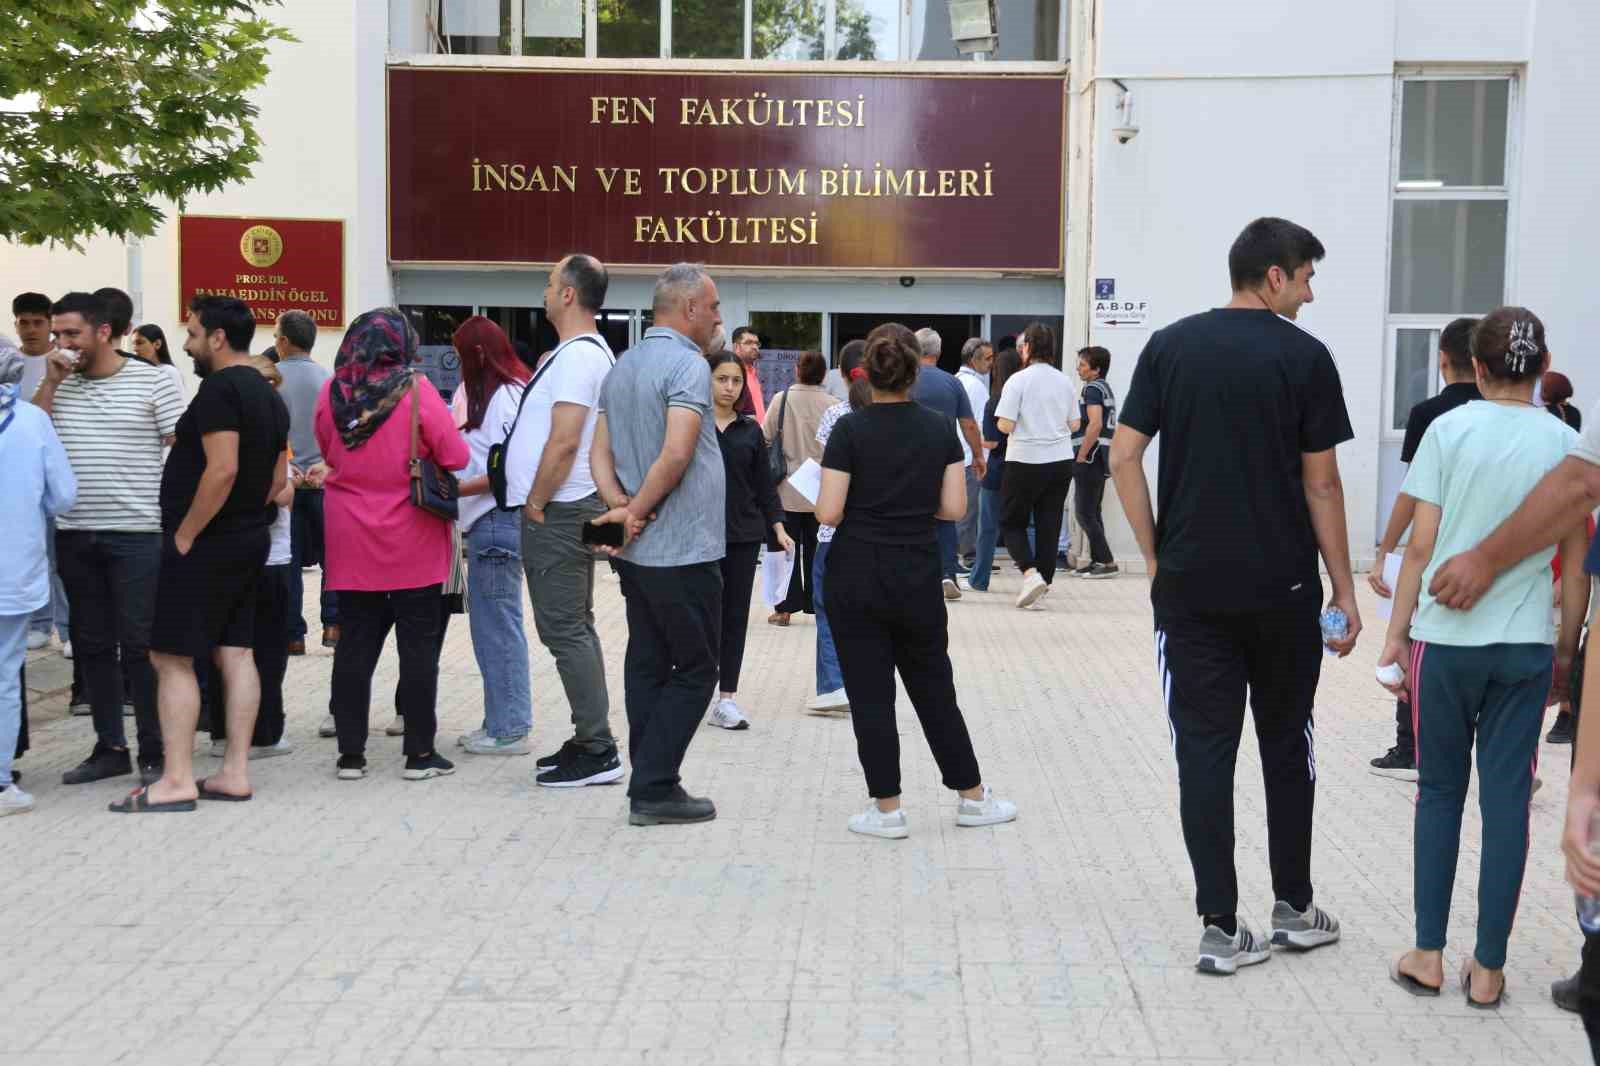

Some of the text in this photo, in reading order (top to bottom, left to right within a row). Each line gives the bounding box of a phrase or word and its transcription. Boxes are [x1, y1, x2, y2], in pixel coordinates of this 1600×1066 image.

[590, 91, 866, 128] FEN FAKÜLTESİ
[471, 157, 995, 197] İNSAN VE TOPLUM BİLİMLERİ
[634, 209, 819, 245] FAKÜLTESİ
[288, 287, 329, 303] ÖGEL
